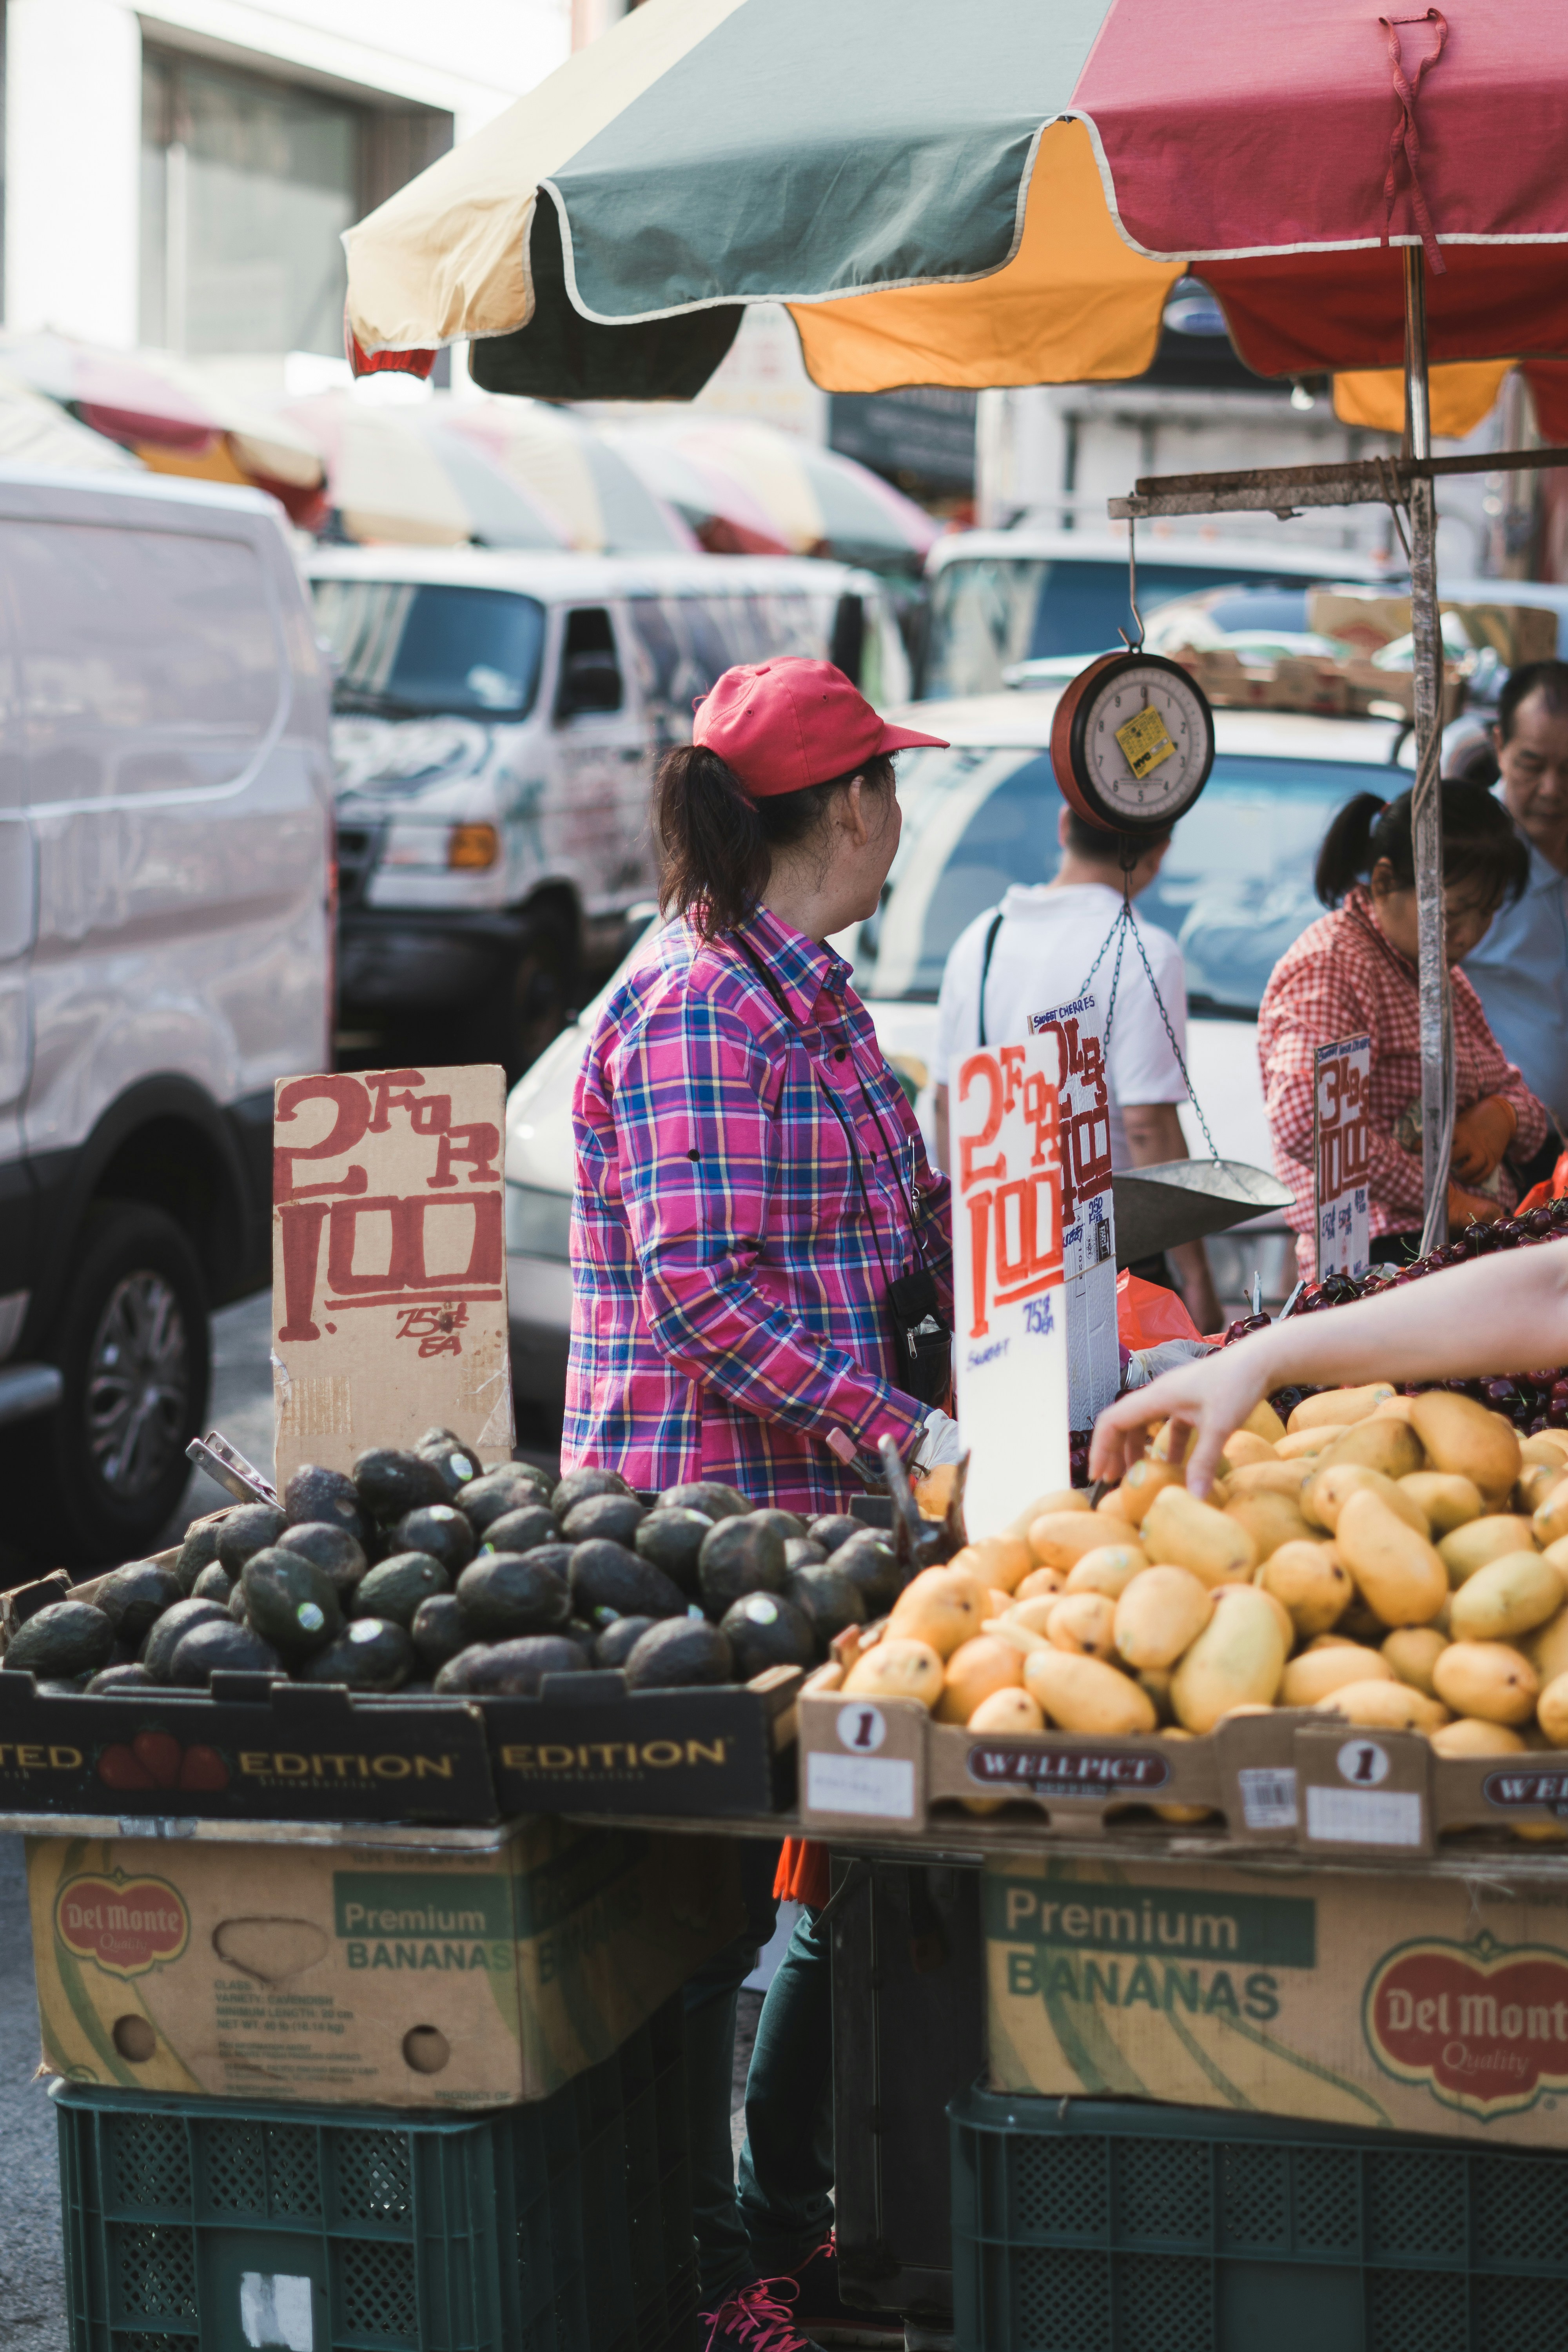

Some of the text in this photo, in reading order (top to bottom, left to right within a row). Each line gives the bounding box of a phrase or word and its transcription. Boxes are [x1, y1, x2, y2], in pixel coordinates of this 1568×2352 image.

[1033, 995, 1095, 1028] SWEET CHERRIES
[1319, 1059, 1340, 1129] 3
[959, 1045, 1061, 1195] 2 FOR
[273, 1069, 501, 1205] 2 FOR
[418, 1336, 462, 1357] EA
[855, 1711, 874, 1747] 1
[0, 1743, 83, 1769] TED
[239, 1751, 454, 1780] EDITION
[501, 1737, 726, 1770] EDITION
[1354, 1748, 1375, 1781] 1
[67, 1903, 180, 1933] Del Monte
[345, 1903, 486, 1932] Premium
[1005, 1888, 1239, 1950] Premium
[100, 1933, 148, 1953] Quality
[347, 1942, 511, 1973] BANANAS
[1006, 1950, 1280, 2021] BANANAS
[217, 2020, 238, 2029] NET
[1386, 1987, 1450, 2035] Del
[1441, 2041, 1530, 2078] Quality
